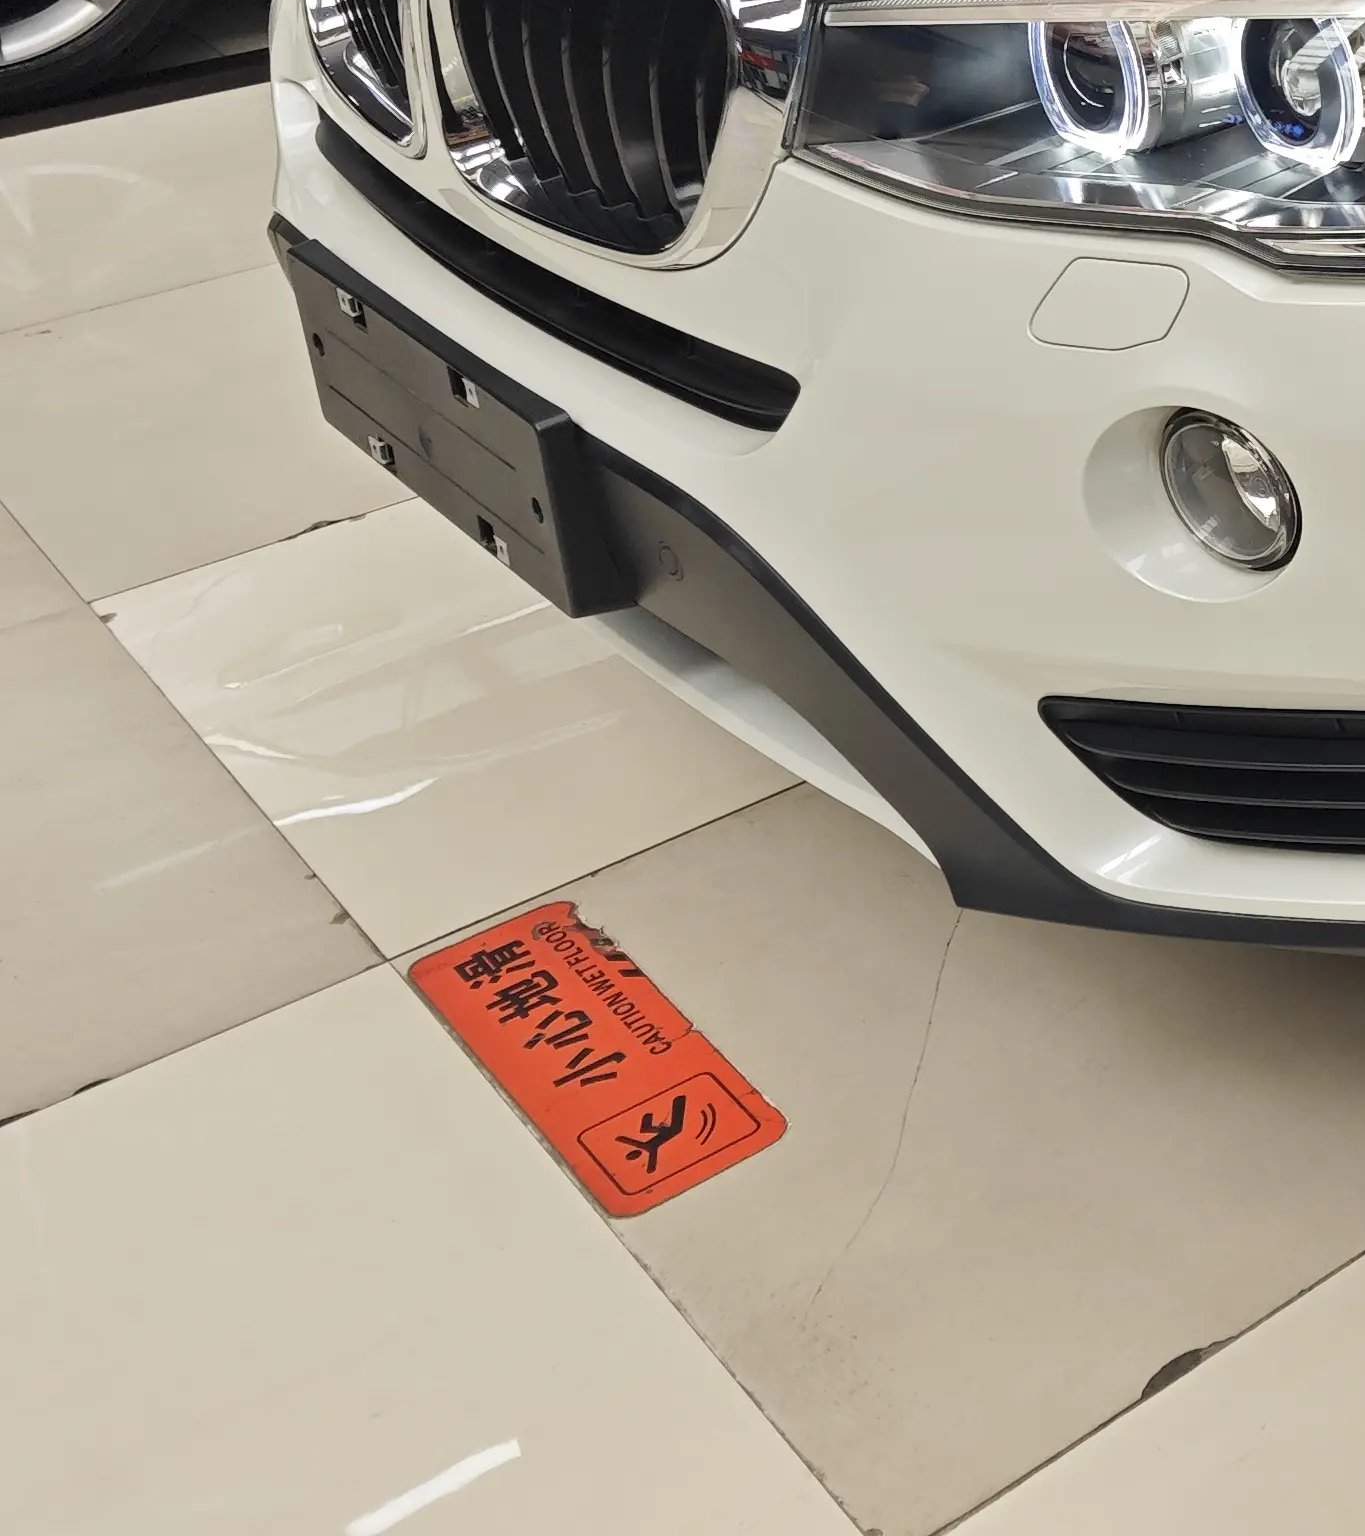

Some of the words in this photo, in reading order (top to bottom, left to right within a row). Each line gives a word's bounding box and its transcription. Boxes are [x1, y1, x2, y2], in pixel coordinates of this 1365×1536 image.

[538, 921, 585, 969] FLOOR
[578, 963, 617, 997] WET
[452, 939, 628, 1088] 小心地滑
[605, 989, 673, 1056] CAUTION
